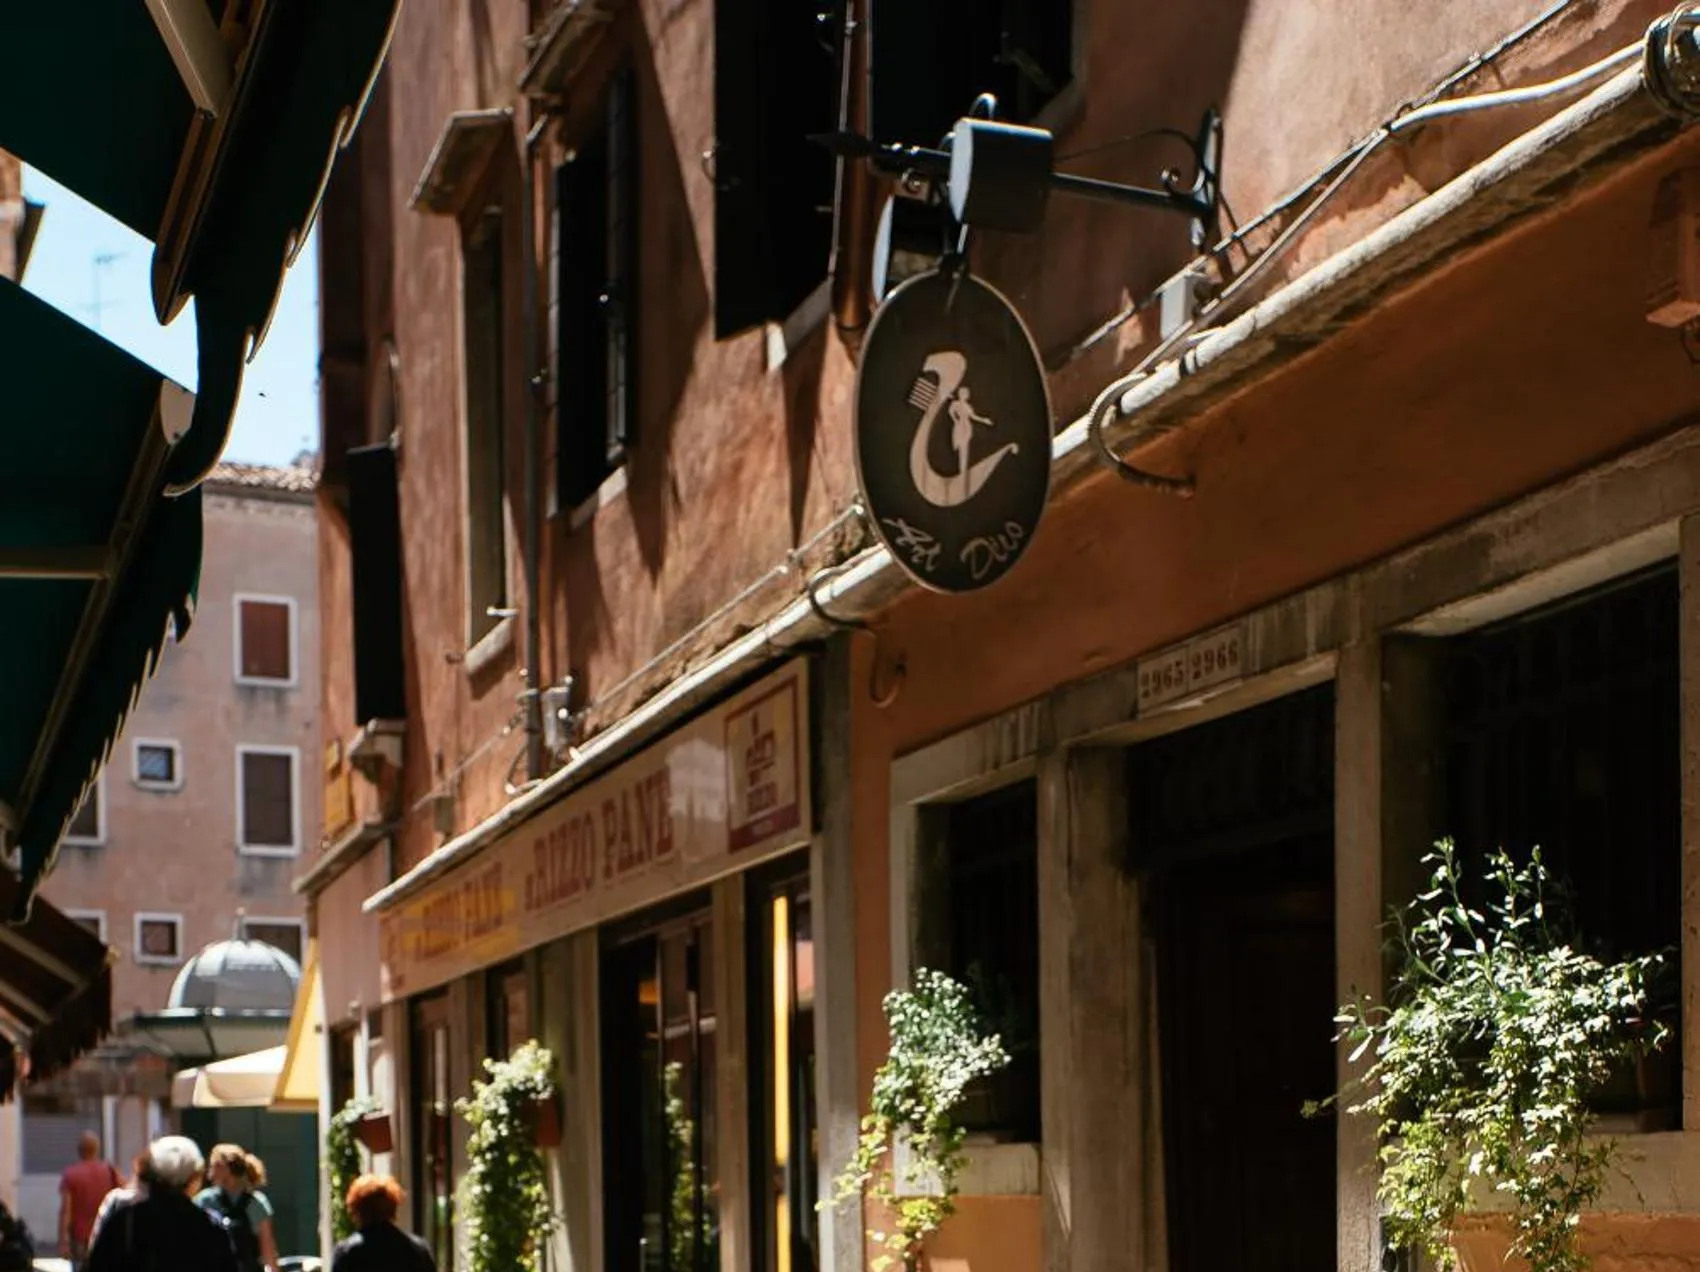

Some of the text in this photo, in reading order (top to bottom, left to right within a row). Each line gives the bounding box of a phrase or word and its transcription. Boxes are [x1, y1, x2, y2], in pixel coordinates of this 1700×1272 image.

[1141, 639, 1237, 698] 2965 2966
[601, 766, 675, 880] PANE
